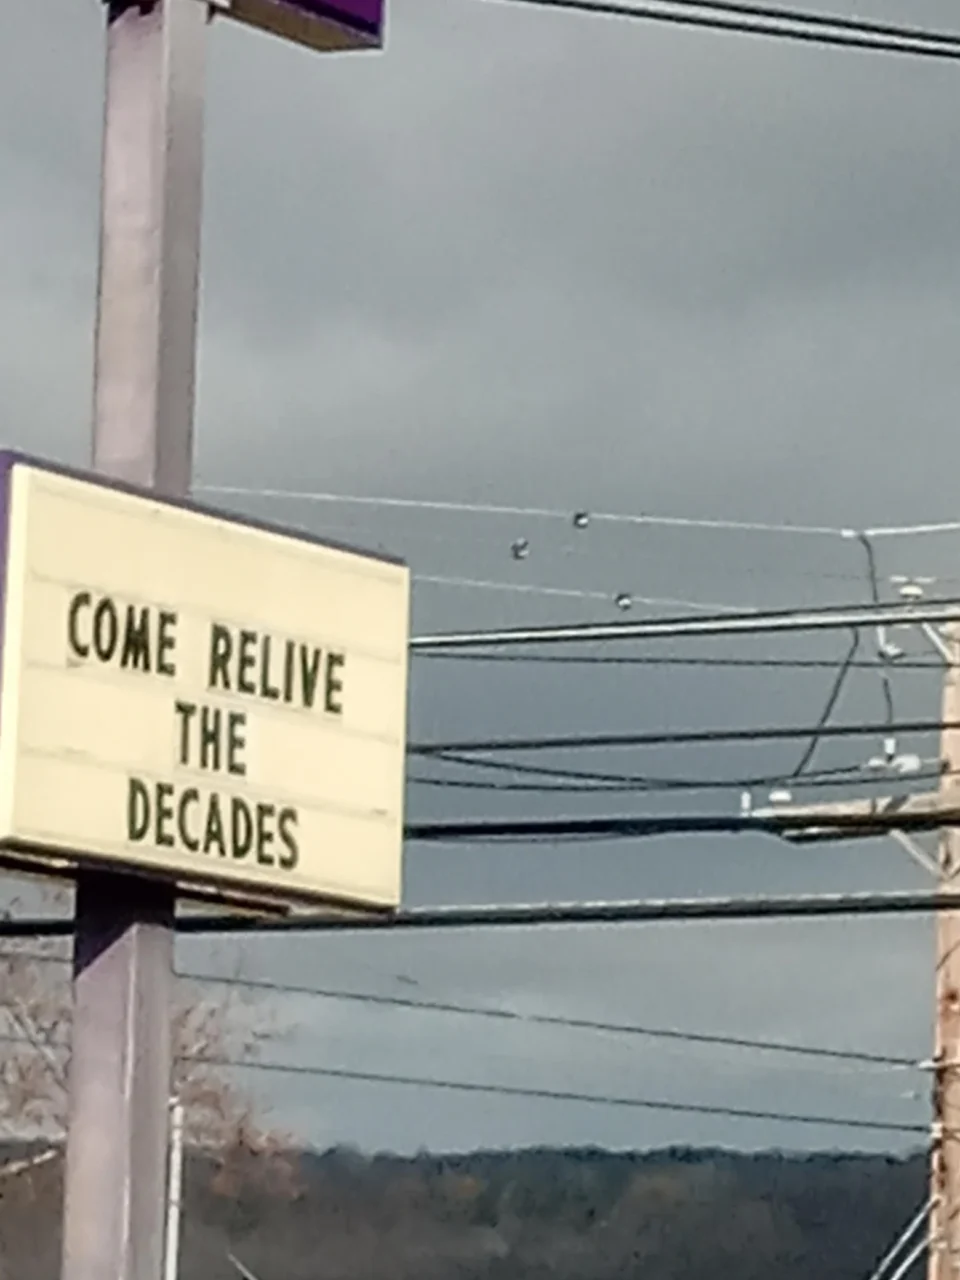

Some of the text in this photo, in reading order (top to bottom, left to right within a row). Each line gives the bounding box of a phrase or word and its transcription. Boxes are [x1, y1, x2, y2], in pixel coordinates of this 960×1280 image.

[67, 591, 345, 714] COME RELIVE
[175, 700, 247, 776] THE
[128, 777, 299, 870] DECADES
